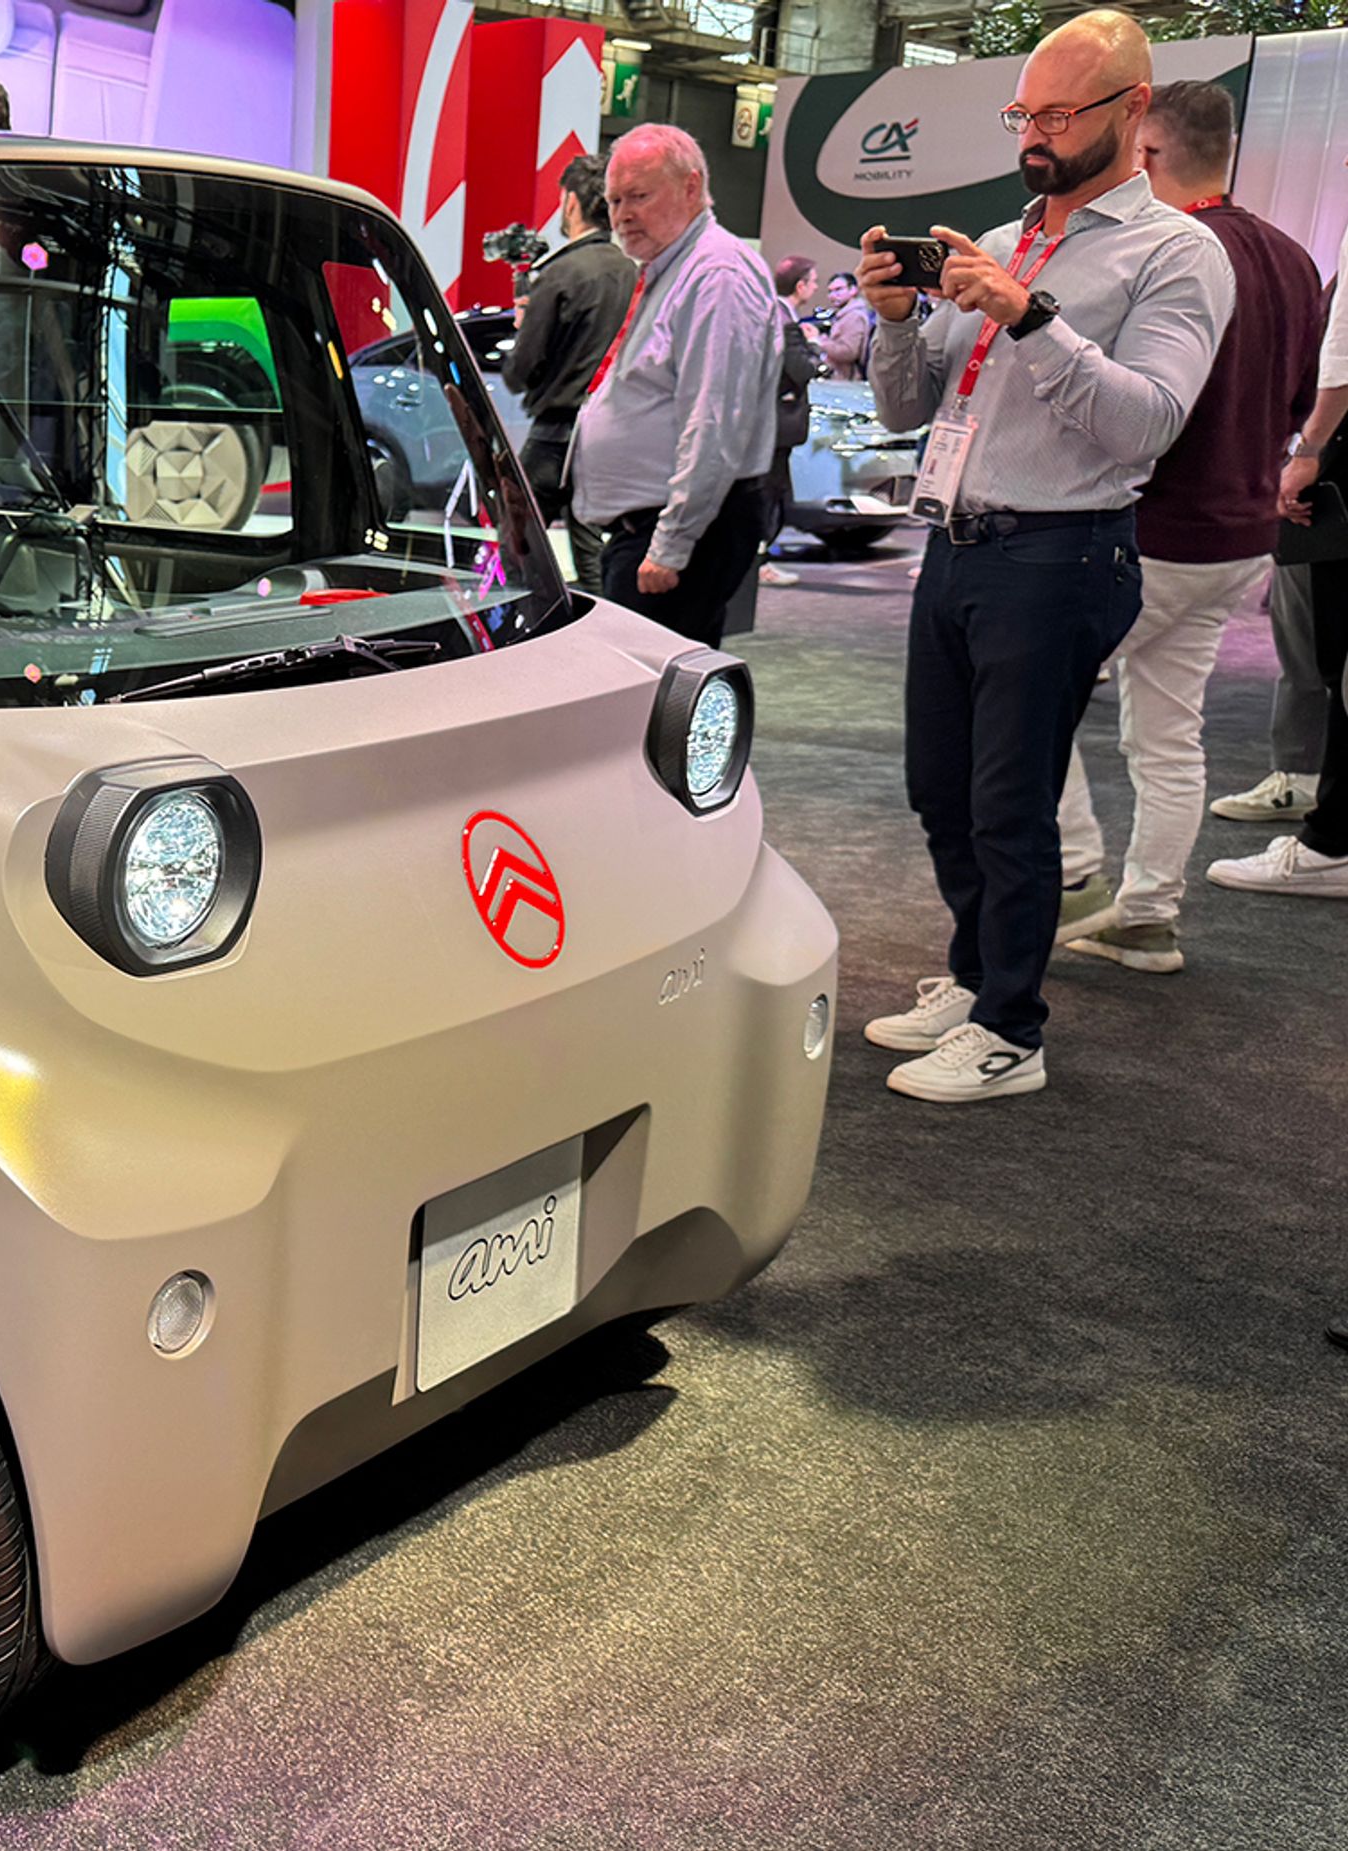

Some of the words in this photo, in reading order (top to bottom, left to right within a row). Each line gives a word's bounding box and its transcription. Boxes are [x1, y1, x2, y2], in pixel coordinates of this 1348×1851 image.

[861, 119, 918, 155] CA
[854, 170, 913, 180] MOBILITY
[659, 946, 705, 1006] ami
[448, 1194, 557, 1301] ami
